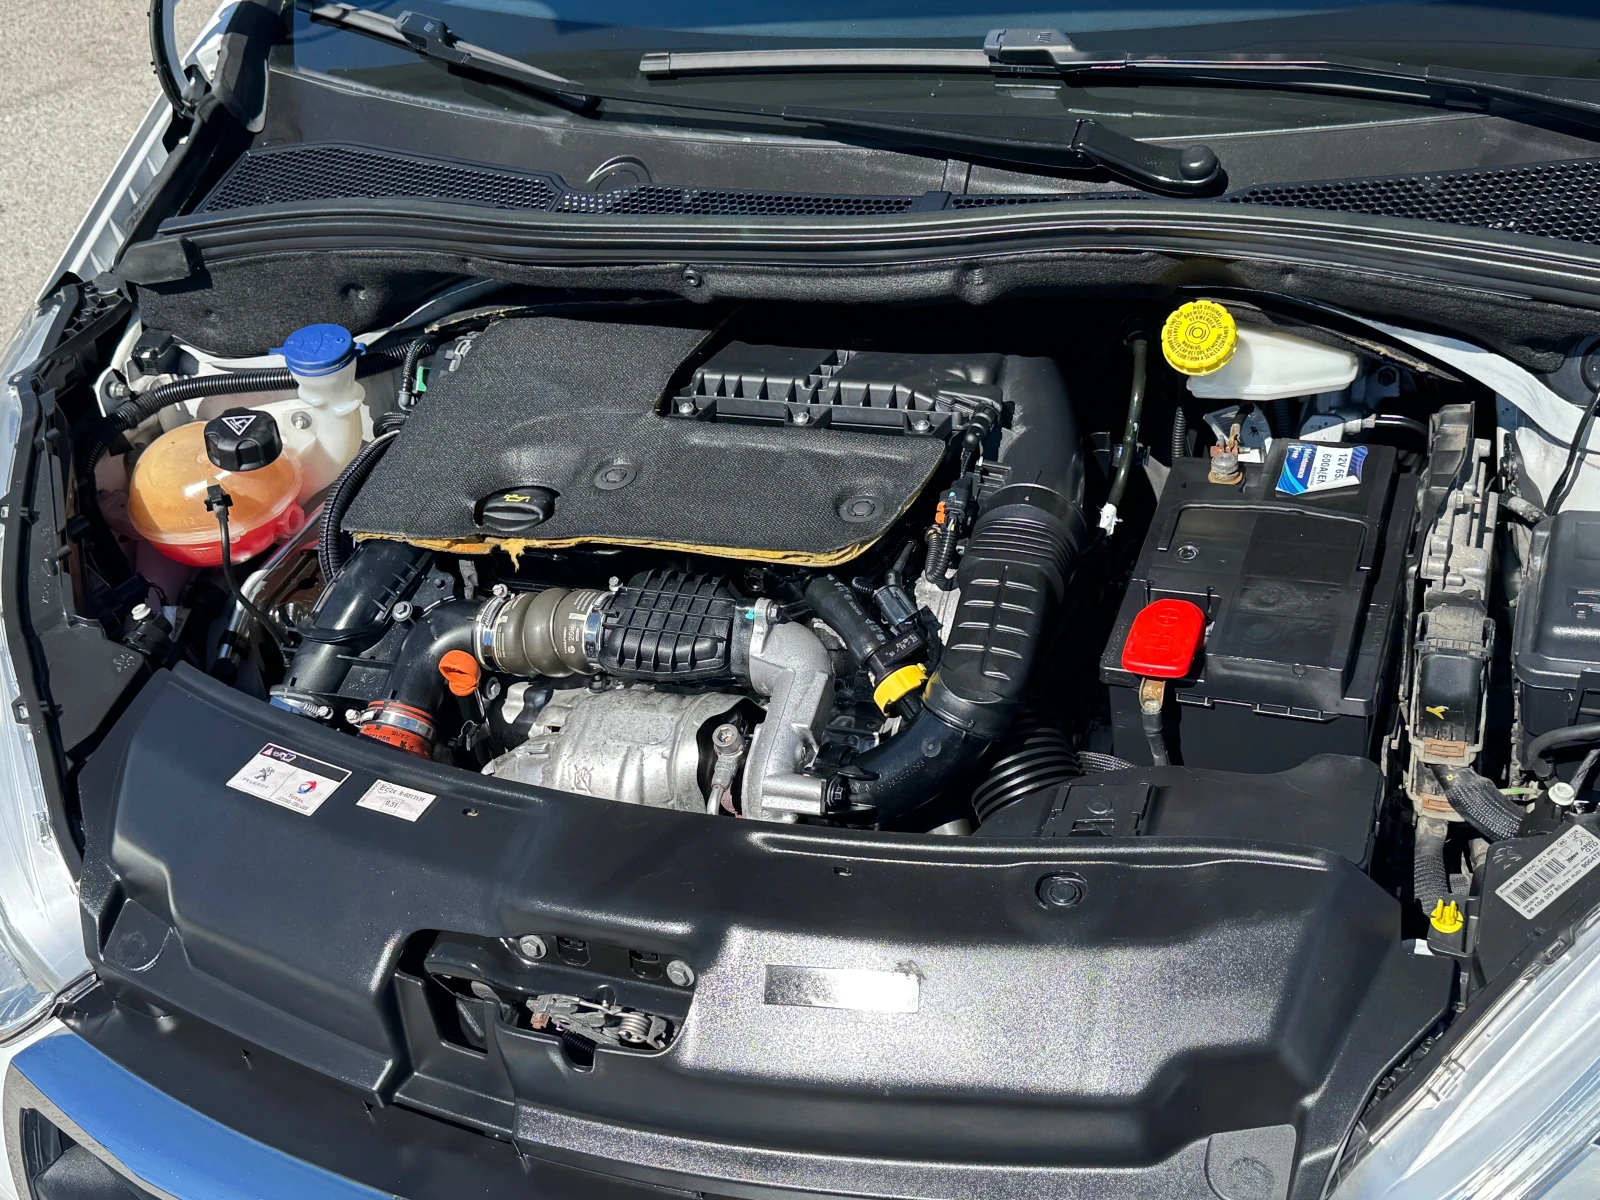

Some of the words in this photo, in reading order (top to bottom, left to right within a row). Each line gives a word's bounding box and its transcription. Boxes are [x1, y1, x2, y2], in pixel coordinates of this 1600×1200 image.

[1204, 304, 1223, 318] ORIGINAL
[1292, 447, 1302, 459] Free
[1297, 448, 1312, 478] Maintenance
[1336, 453, 1348, 467] 12V
[1334, 469, 1345, 480] 65
[242, 777, 269, 790] PEUGEOT
[288, 793, 304, 803] TOTAL
